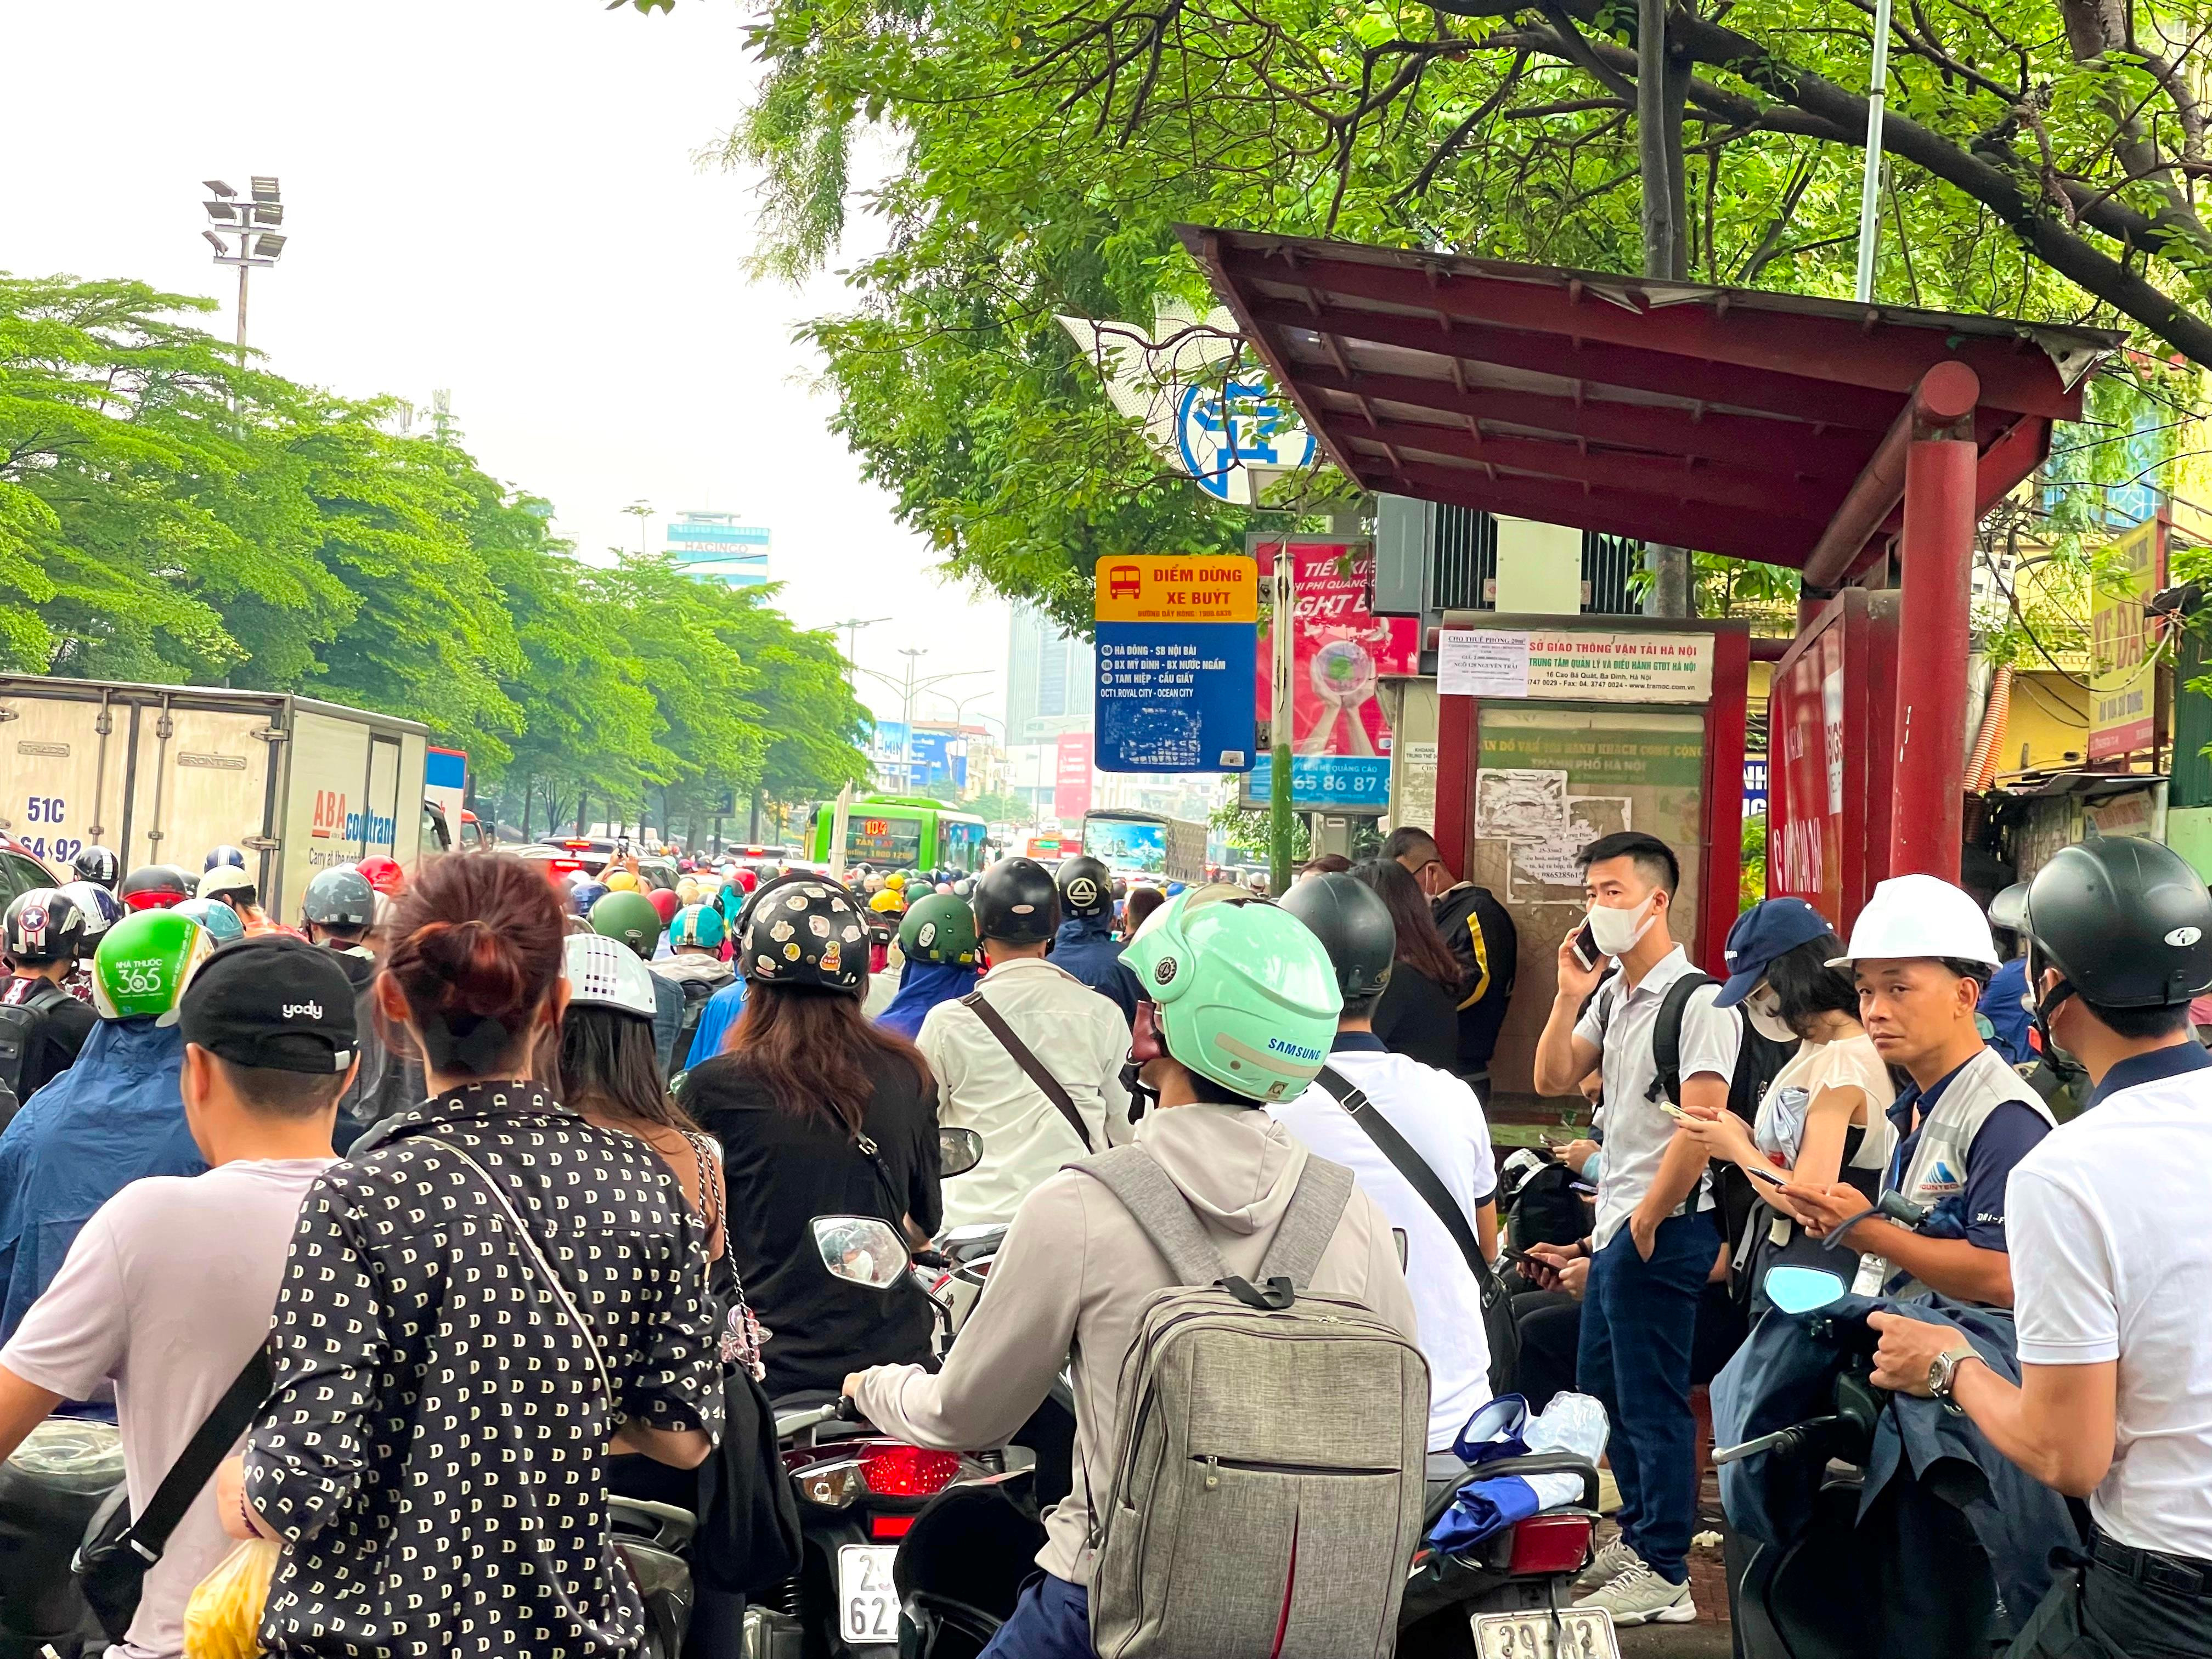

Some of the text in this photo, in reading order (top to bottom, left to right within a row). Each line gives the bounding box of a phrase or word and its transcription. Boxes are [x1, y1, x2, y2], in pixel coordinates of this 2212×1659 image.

[686, 541, 748, 553] HACINCO
[1199, 566, 1242, 582] DỪNG
[1167, 588, 1231, 604] XE BUÝT
[1530, 639, 1543, 651] SỞ
[1576, 643, 1611, 653] THÔNG
[1615, 644, 1637, 656] VẬN
[1661, 645, 1674, 655] HÀ
[1679, 645, 1696, 657] NỘI
[1114, 660, 1125, 669] BX
[1167, 660, 1177, 669] BX
[1554, 657, 1569, 667] TÂM
[1673, 661, 1681, 671] HÀ
[1684, 661, 1696, 673] NỘI
[1115, 674, 1131, 683] TAM
[1138, 689, 1152, 697] CITY
[1158, 689, 1179, 697] OCEAN
[1180, 689, 1193, 697] CITY
[21, 743, 67, 755] THACO
[180, 754, 245, 768] FRONTIER
[1323, 775, 1346, 791] 86
[1354, 777, 1376, 792] 87
[27, 797, 65, 823] 51C
[313, 790, 346, 828] ABA
[865, 821, 888, 836] 104
[55, 839, 81, 862] 92
[309, 847, 326, 869] Carry
[328, 851, 333, 865] at
[335, 850, 345, 866] the
[116, 959, 131, 969] NHÀ
[117, 968, 161, 994] 365
[283, 1000, 323, 1019] yody
[1268, 1038, 1321, 1060] SAMSUNG
[851, 1597, 898, 1635] 62
